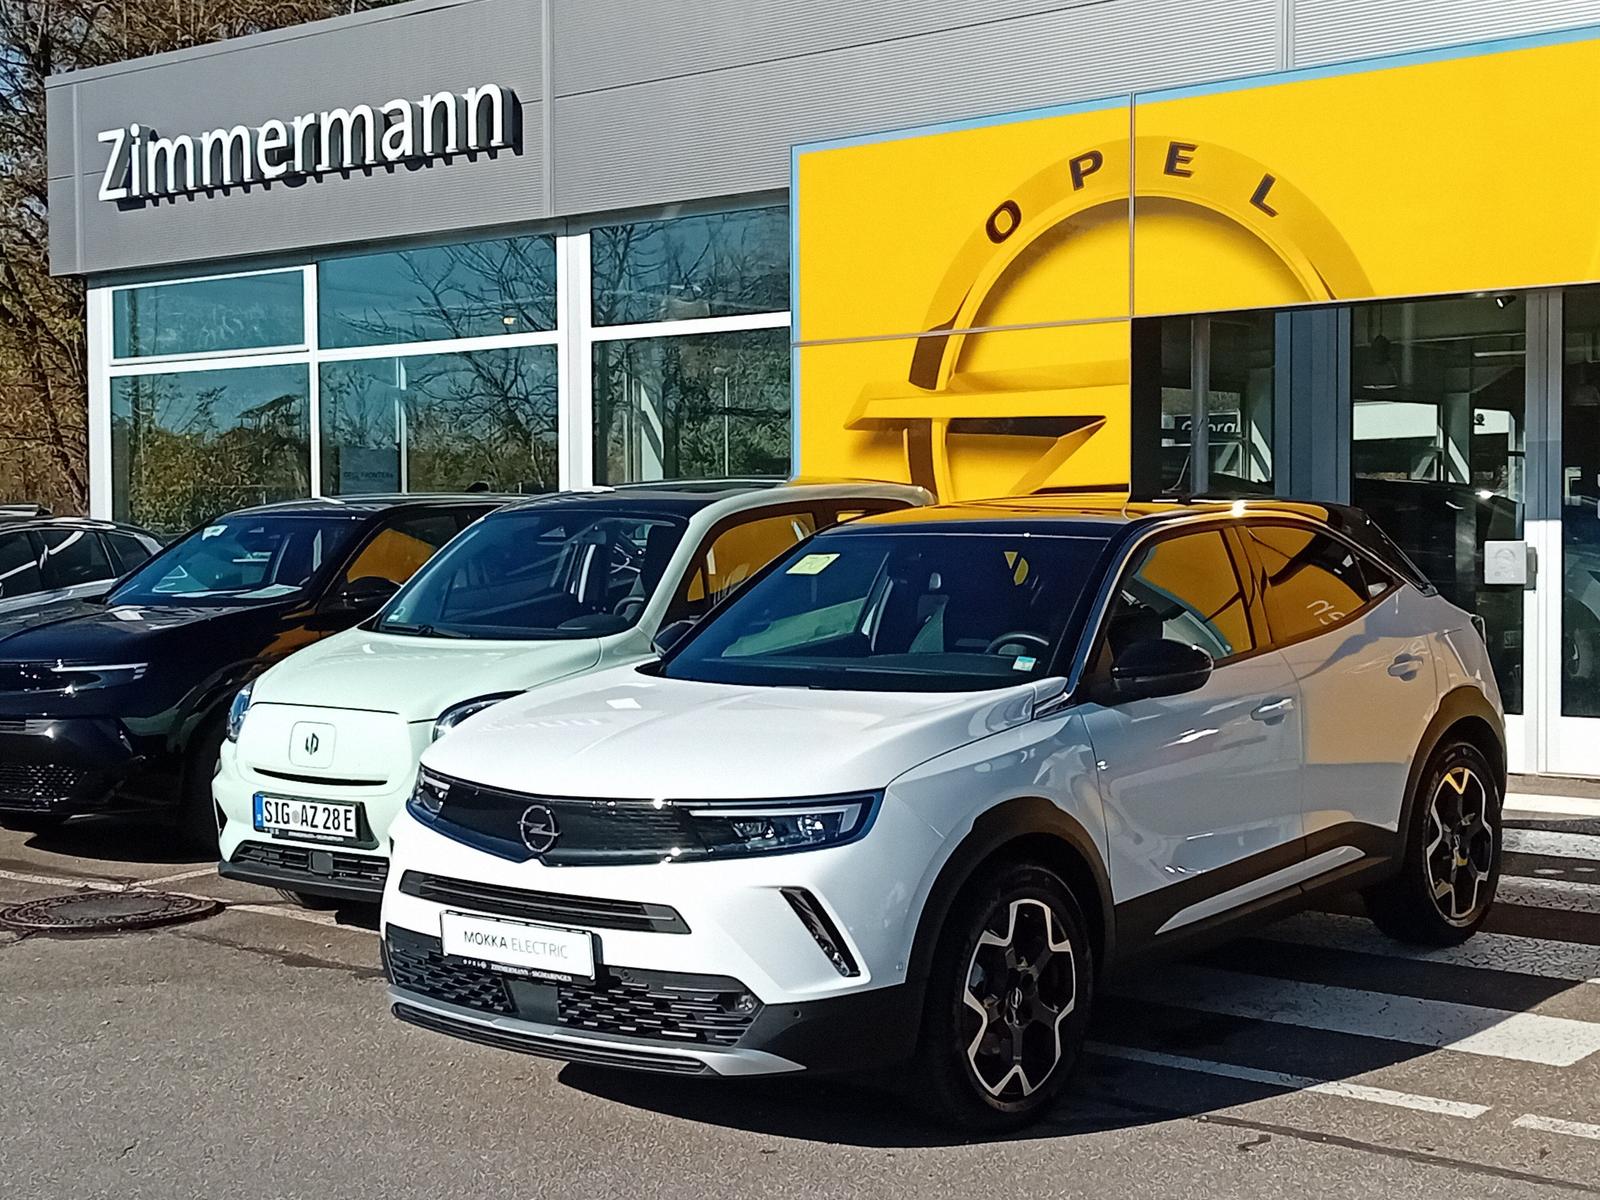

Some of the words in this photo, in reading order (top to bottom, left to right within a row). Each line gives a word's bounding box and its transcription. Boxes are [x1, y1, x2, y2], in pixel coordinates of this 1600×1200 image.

[97, 83, 504, 201] Zimmermann
[985, 141, 1279, 244] OPEL
[264, 800, 291, 825] SIG
[300, 804, 319, 829] AZ
[464, 931, 508, 948] MOKKA
[511, 937, 569, 959] ELECTRIC
